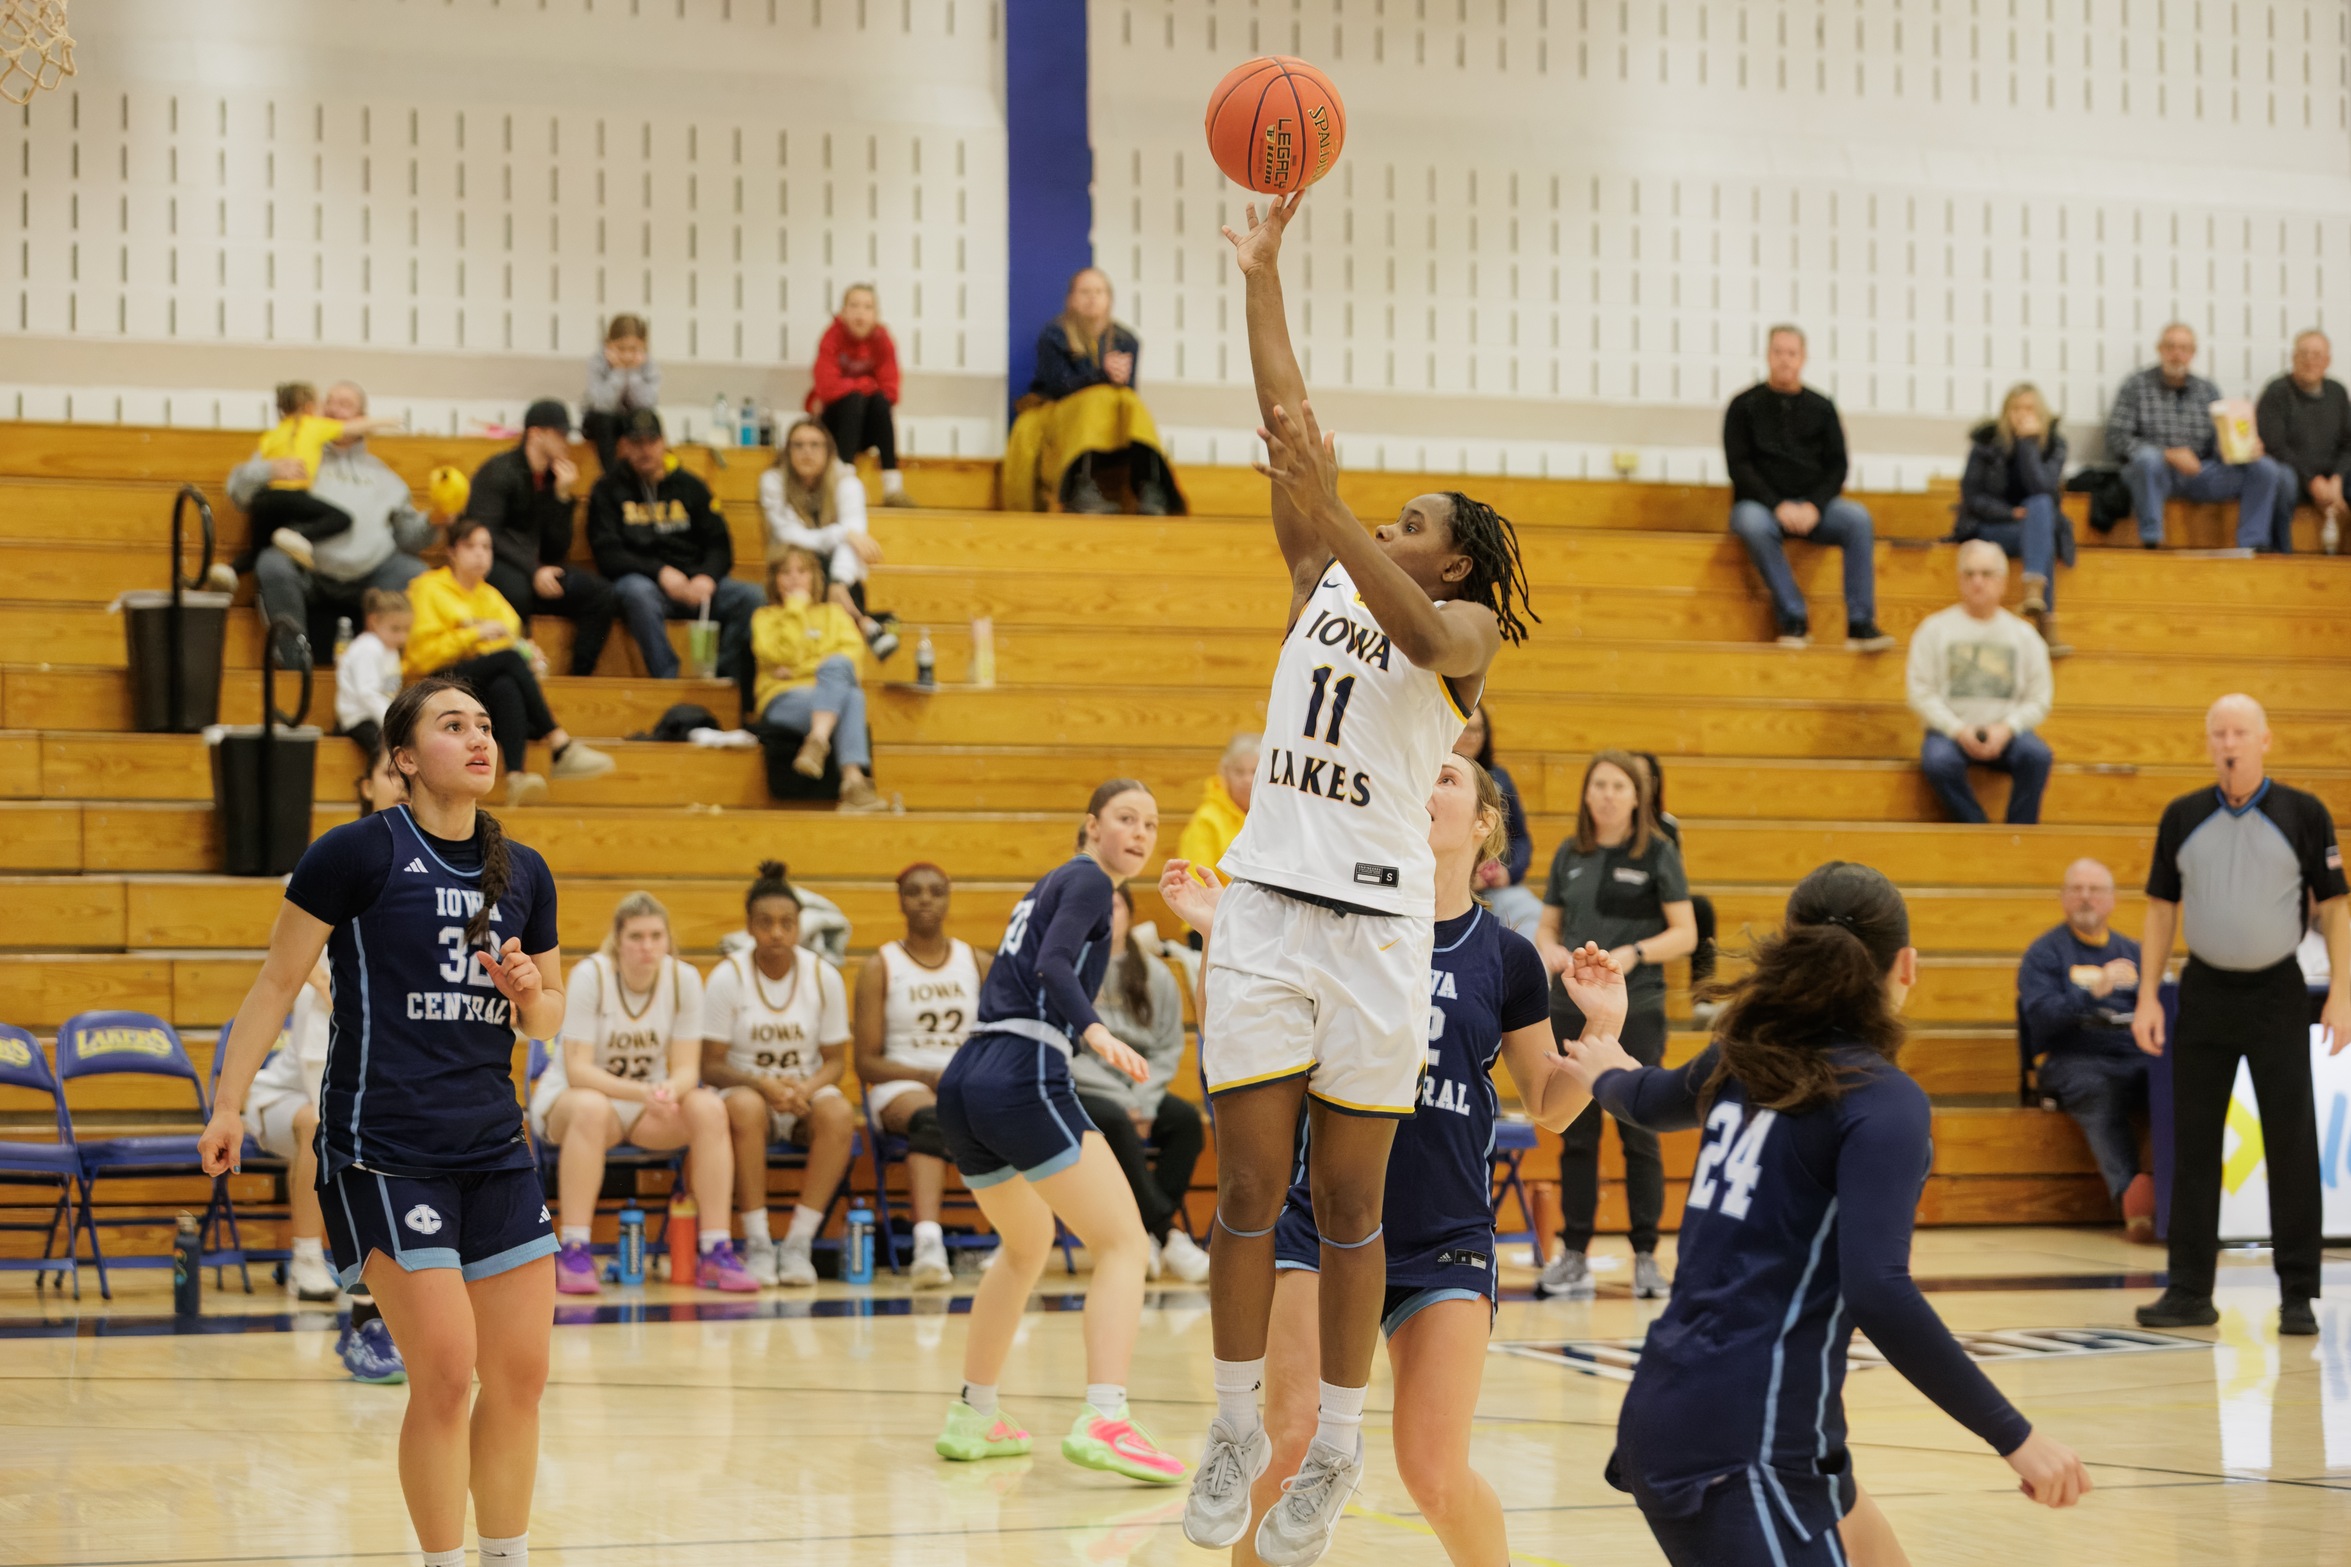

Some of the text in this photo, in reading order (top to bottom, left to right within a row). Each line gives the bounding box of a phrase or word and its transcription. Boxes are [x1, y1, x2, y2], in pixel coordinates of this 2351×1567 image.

[1274, 118, 1293, 188] LEGACY
[1305, 608, 1391, 673] IOWA
[1302, 663, 1357, 749] 11
[1269, 748, 1371, 808] LAKES
[1386, 872, 1393, 882] S
[438, 926, 502, 988] 32
[407, 992, 508, 1025] CENTRAL
[910, 981, 966, 1002] IOWA
[608, 1029, 660, 1049] IOWA
[751, 1022, 804, 1042] IOWA
[1686, 1100, 1778, 1220] 24
